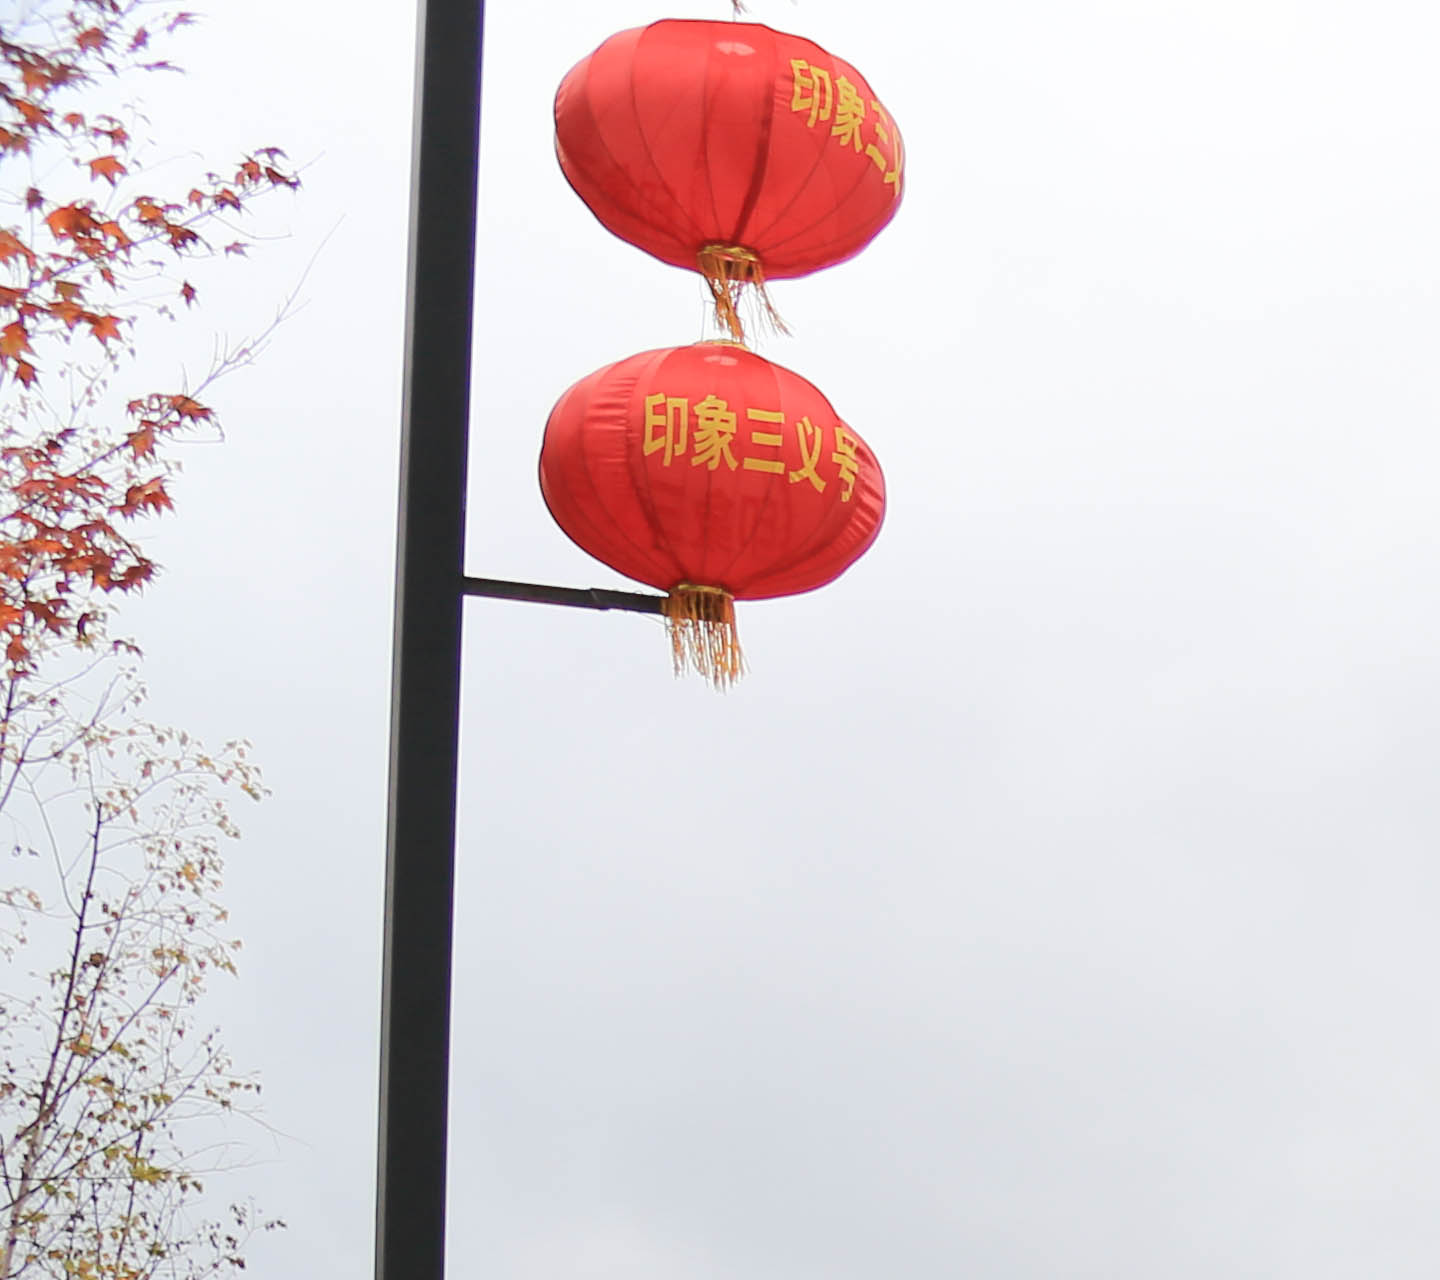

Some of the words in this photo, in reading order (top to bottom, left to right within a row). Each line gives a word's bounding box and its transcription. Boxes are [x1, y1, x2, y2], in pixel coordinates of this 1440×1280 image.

[643, 392, 859, 502] 印象三义号
